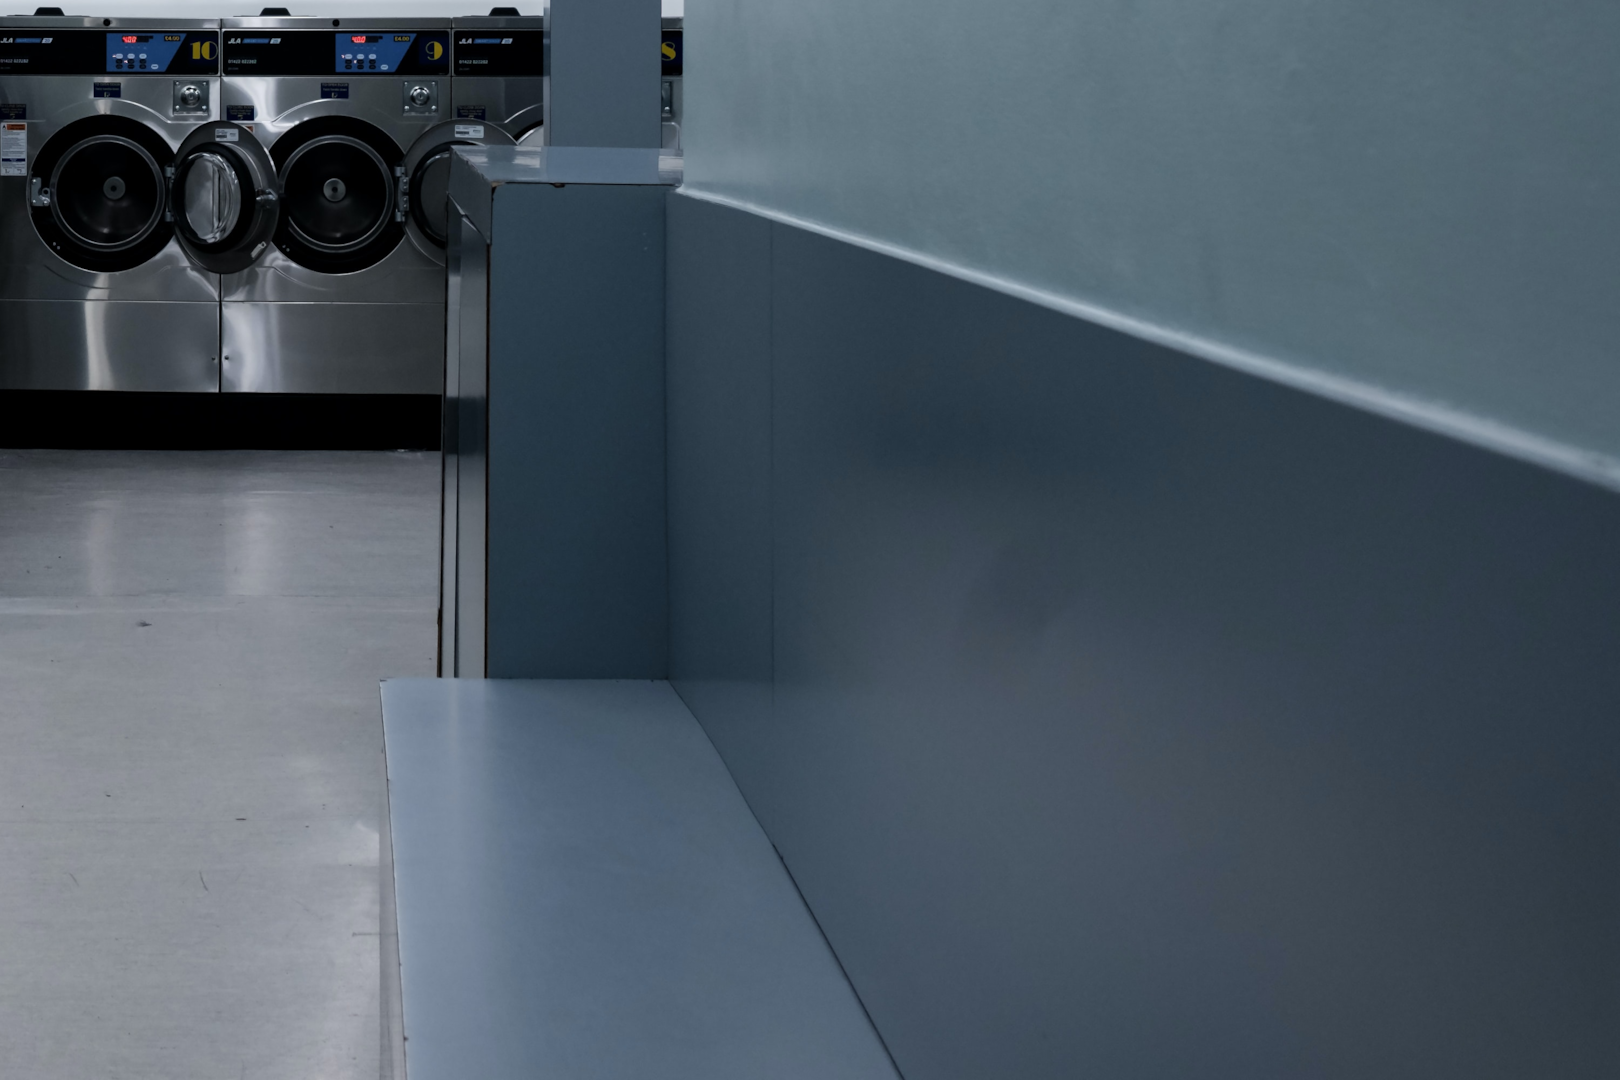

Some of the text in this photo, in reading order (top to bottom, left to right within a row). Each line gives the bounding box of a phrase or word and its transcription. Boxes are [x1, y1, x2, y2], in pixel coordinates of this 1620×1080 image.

[190, 40, 219, 61] 10
[425, 40, 444, 61] 9
[458, 37, 473, 45] JLA
[661, 41, 677, 61] 8
